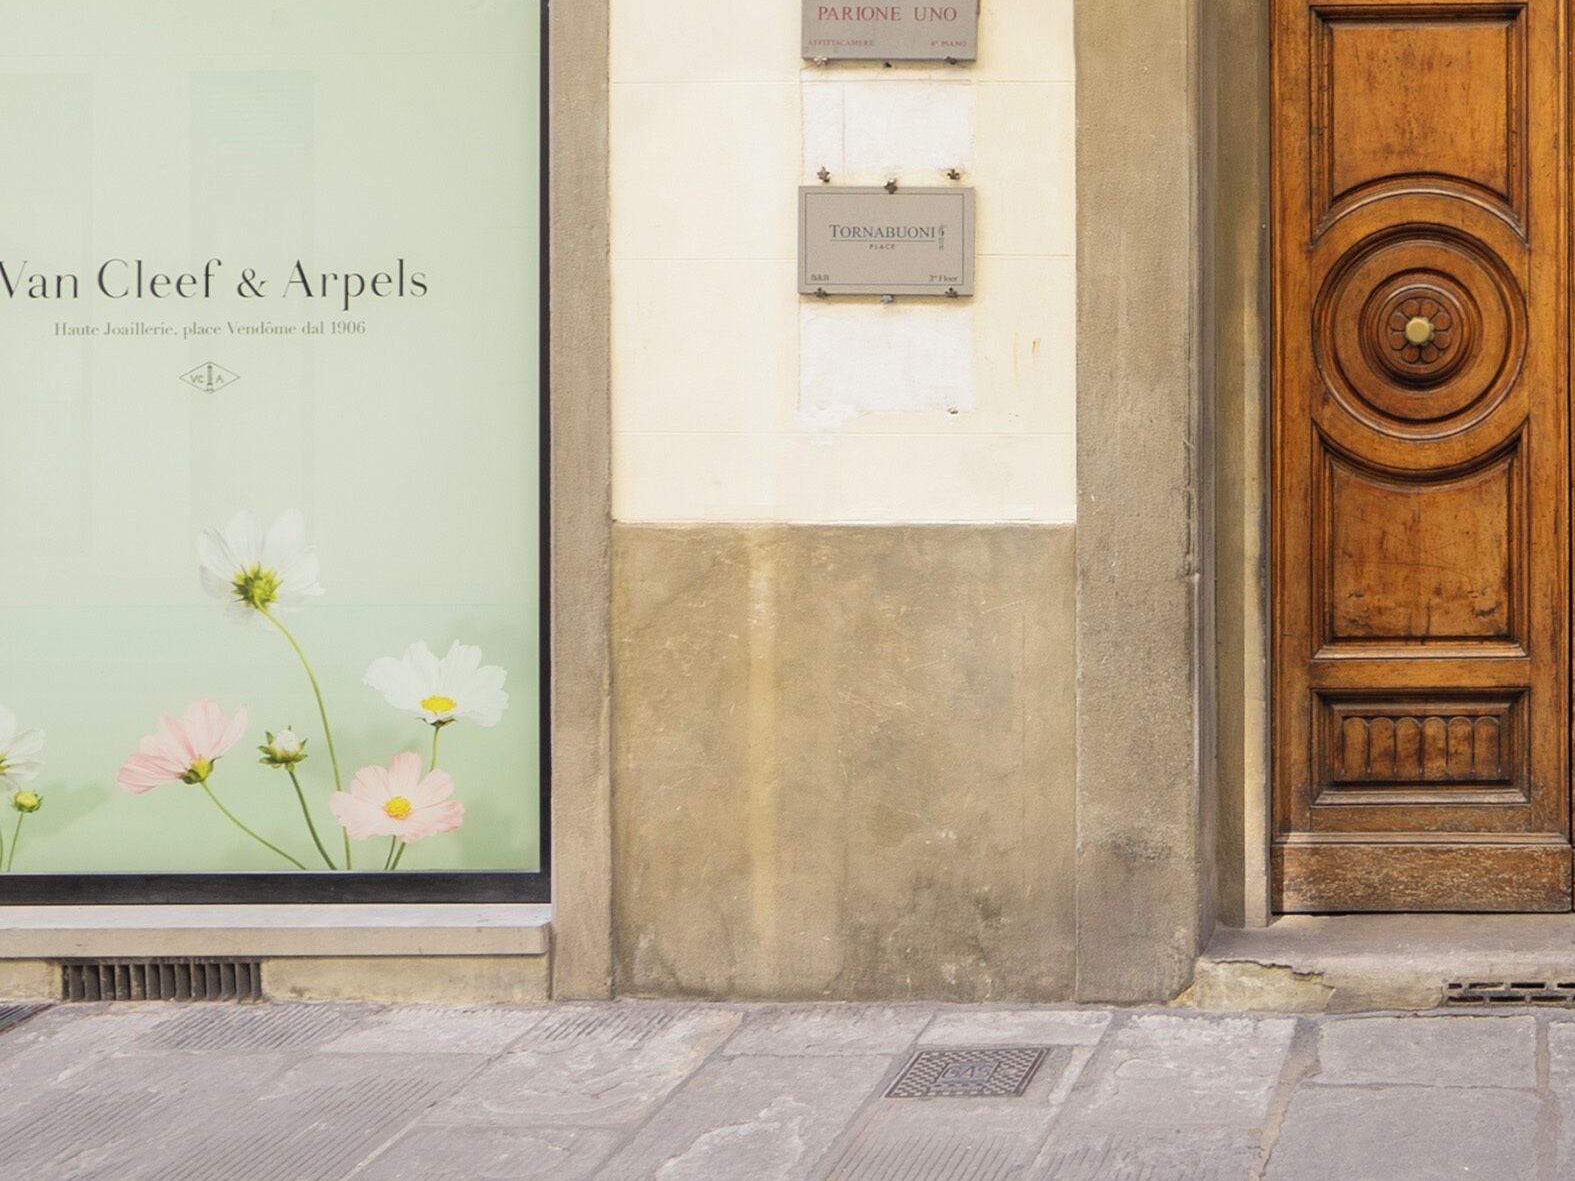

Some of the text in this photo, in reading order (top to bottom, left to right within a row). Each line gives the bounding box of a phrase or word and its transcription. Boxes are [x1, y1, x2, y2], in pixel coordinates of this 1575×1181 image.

[817, 6, 958, 22] PARIONE UNO
[829, 224, 936, 239] TORNABUONI
[0, 258, 429, 311] Van Cleef & Arpels
[54, 321, 100, 336] Haute
[182, 321, 222, 340] place
[227, 320, 297, 336] Vendôme
[301, 320, 325, 336] dal
[330, 320, 367, 336] 1906
